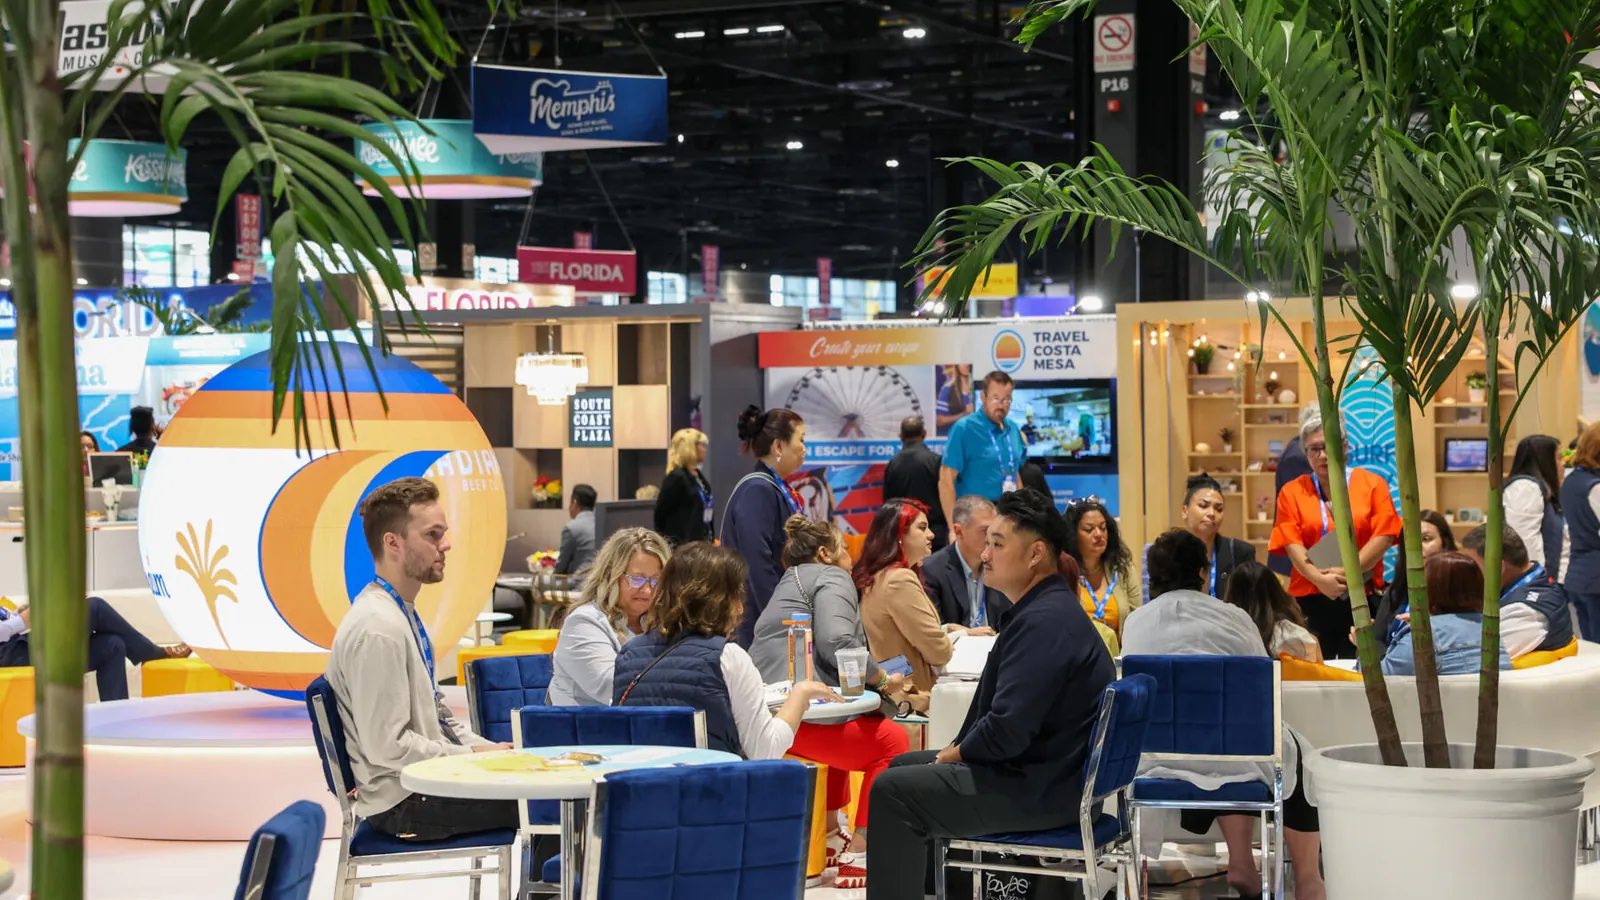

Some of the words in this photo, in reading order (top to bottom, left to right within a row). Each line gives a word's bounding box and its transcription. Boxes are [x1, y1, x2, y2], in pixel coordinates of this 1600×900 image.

[1101, 77, 1129, 92] P16
[530, 91, 616, 130] Memphis
[550, 262, 624, 281] FLORIDA
[1033, 331, 1090, 343] TRAVEL
[1033, 345, 1082, 357] COSTA
[1033, 358, 1076, 370] MESA
[573, 398, 611, 410] SOUTH
[573, 414, 611, 426] COAST
[574, 429, 611, 442] PLAZA
[815, 445, 865, 457] ESCAPE
[869, 444, 894, 456] FOR
